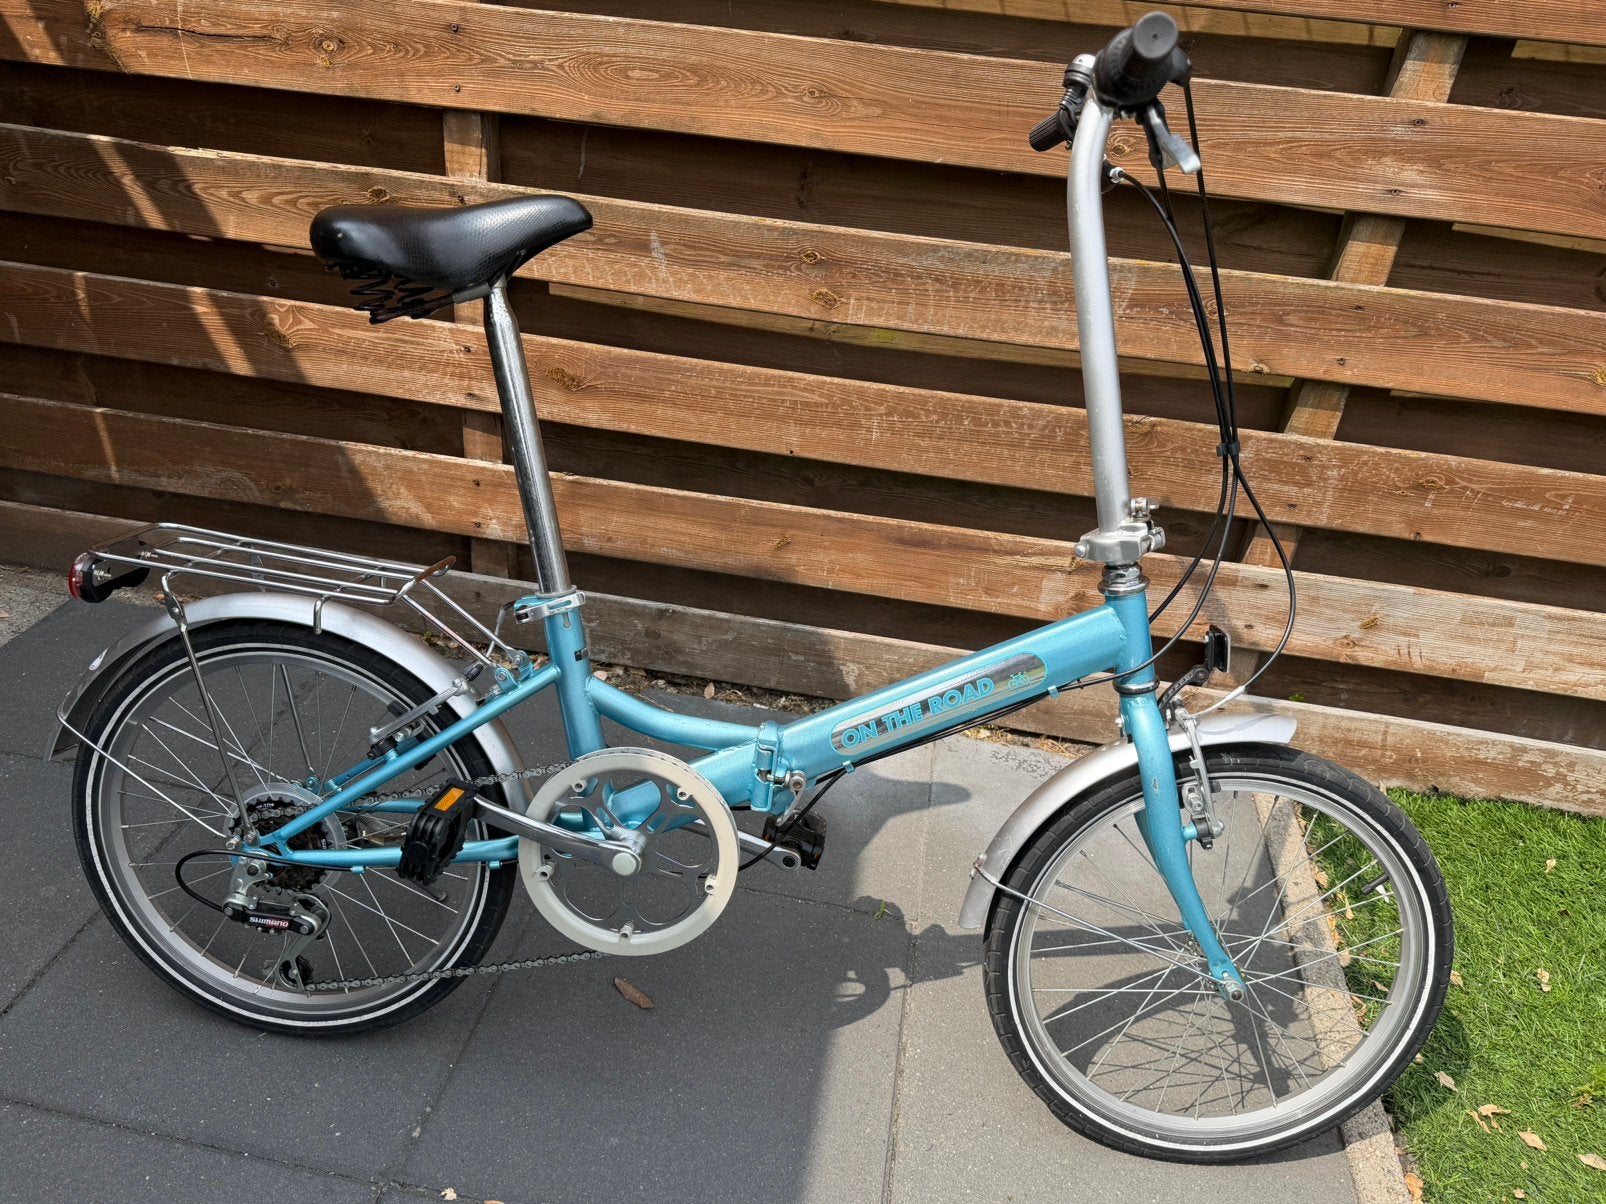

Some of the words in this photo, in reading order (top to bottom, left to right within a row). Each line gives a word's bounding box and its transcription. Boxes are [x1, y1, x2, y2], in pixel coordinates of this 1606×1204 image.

[841, 720, 879, 748] ON
[881, 703, 923, 732] THE
[928, 677, 994, 715] ROAD
[249, 916, 289, 927] SHIMANO
